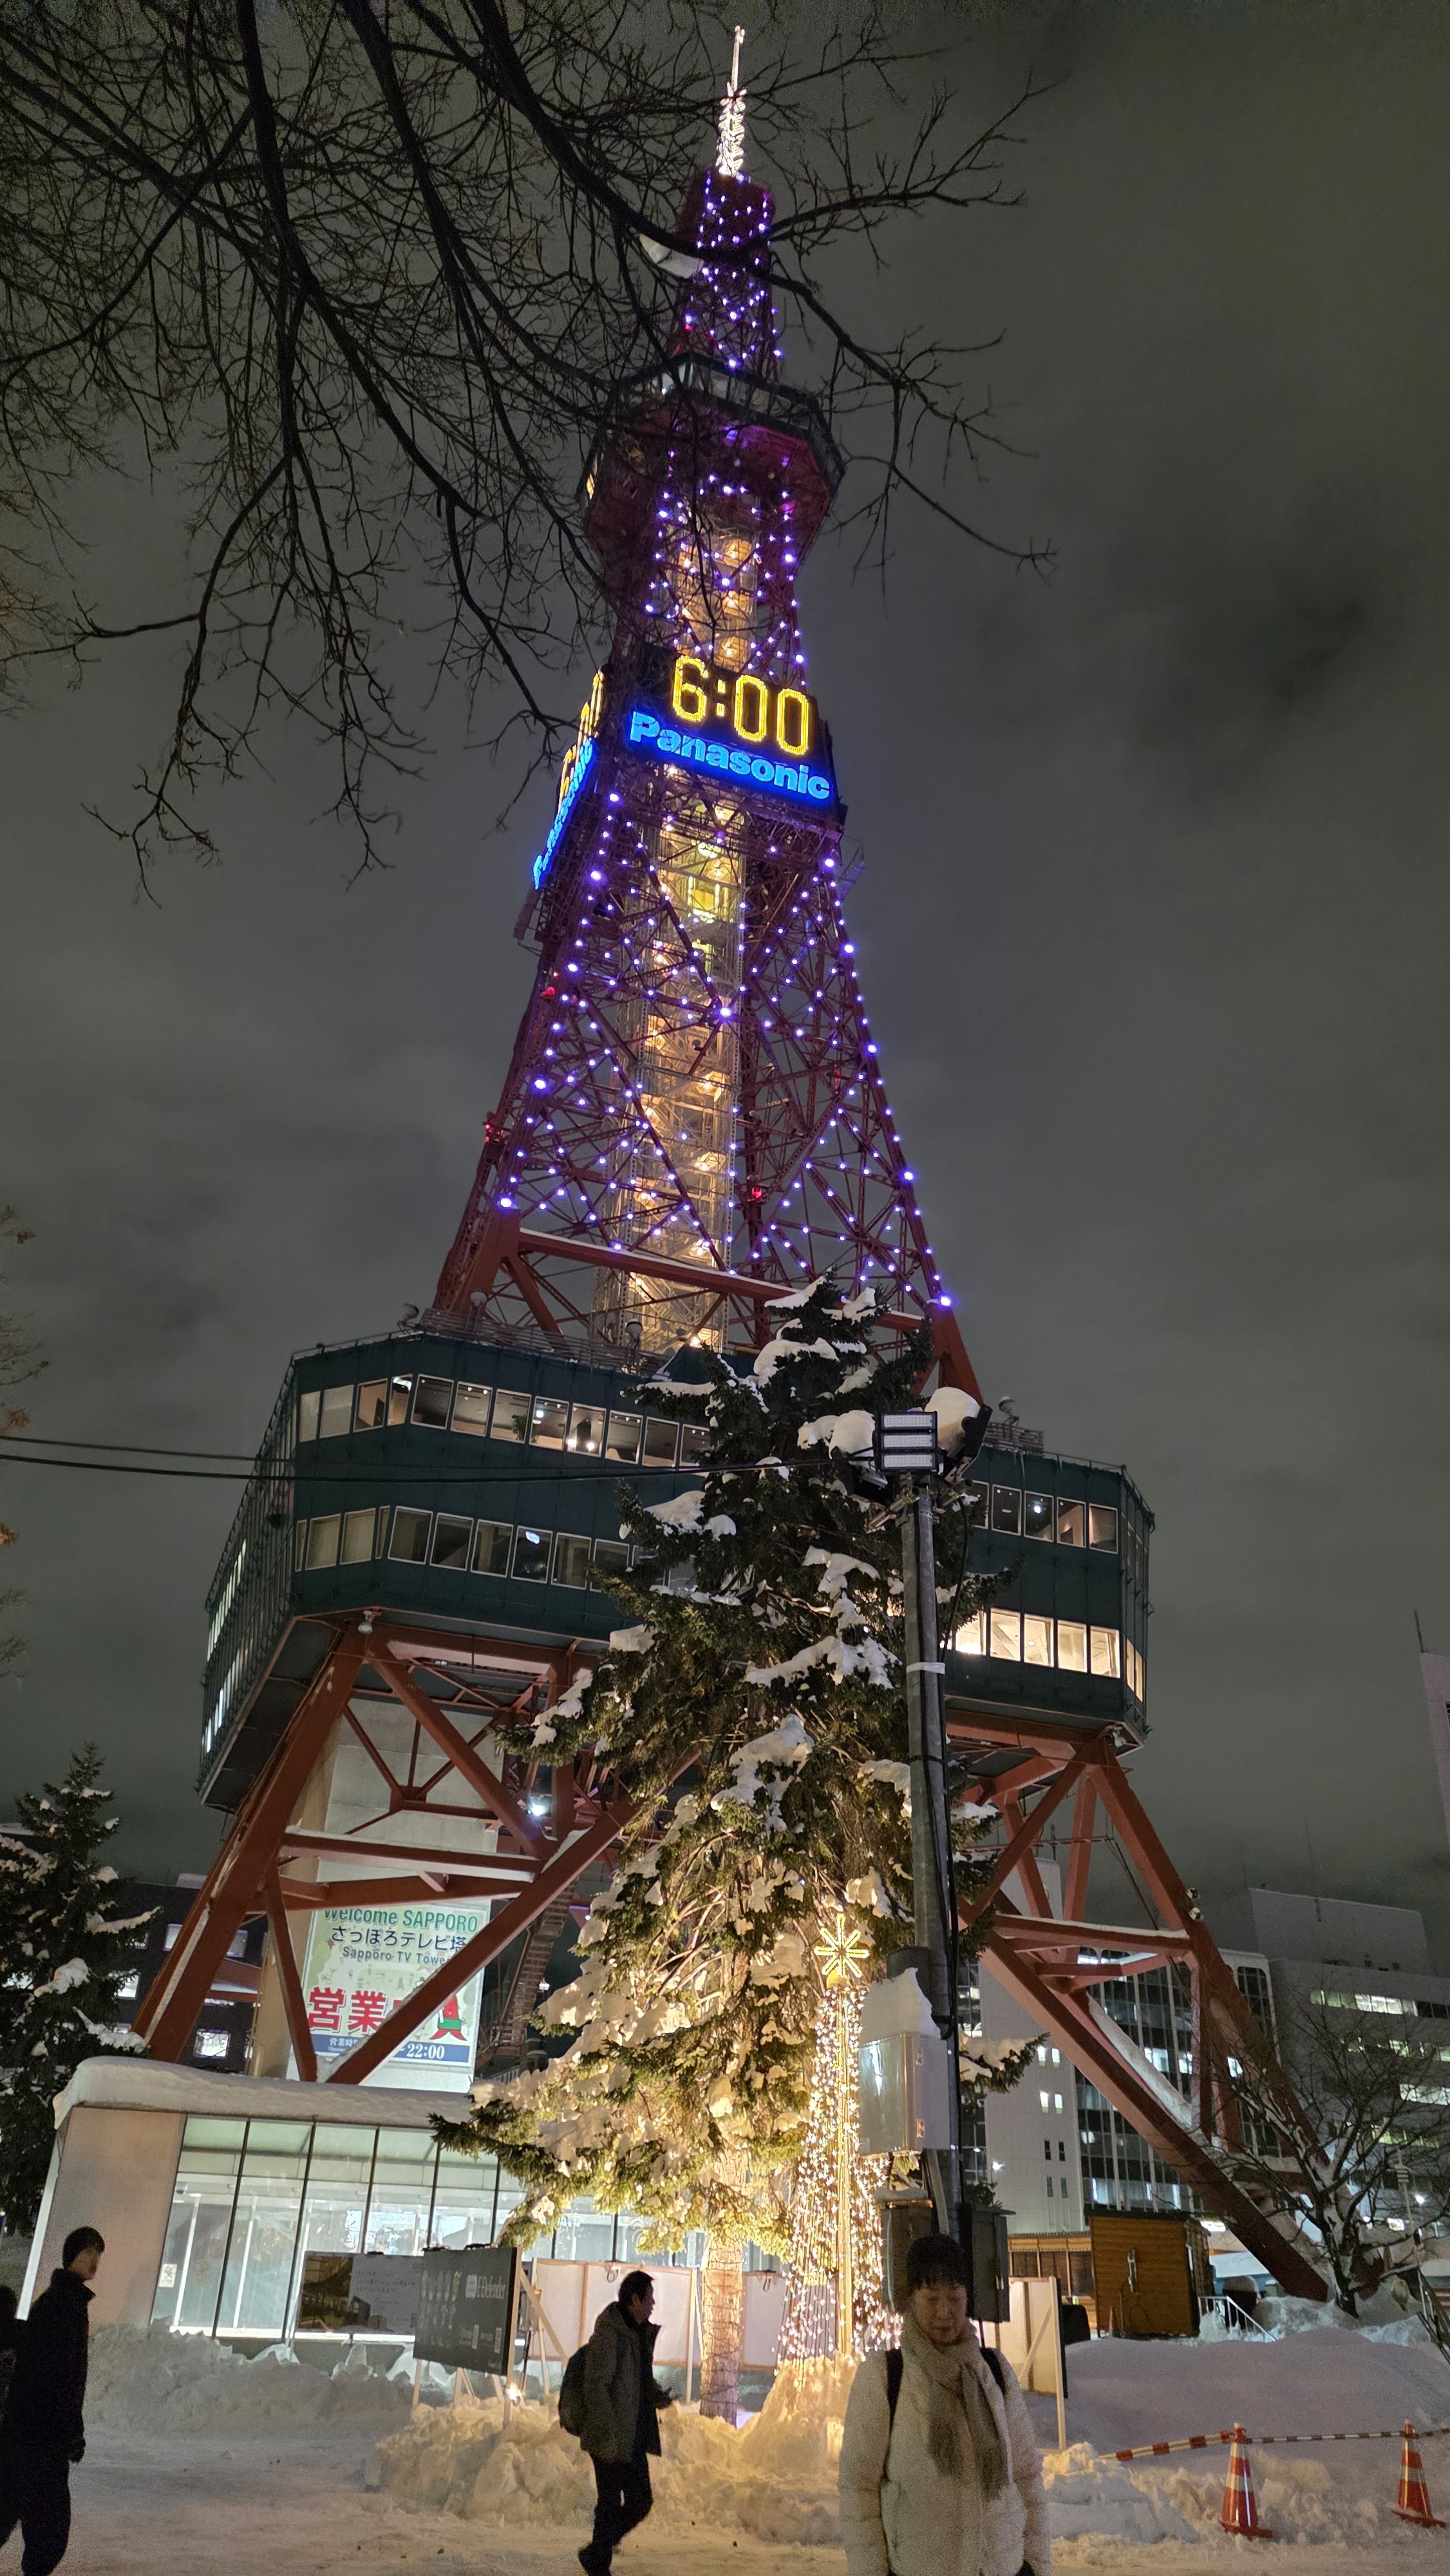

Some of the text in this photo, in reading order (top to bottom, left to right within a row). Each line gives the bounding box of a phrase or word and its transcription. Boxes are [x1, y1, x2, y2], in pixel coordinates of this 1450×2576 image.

[672, 654, 810, 755] 6:00
[629, 710, 831, 800] Panasonic
[402, 1909, 478, 1932] SAPPORO
[332, 1926, 468, 1953] さっぽろテレビ塔
[343, 1946, 392, 1962] Sapporo
[398, 1951, 412, 1962] TV
[308, 1986, 409, 2033] 営業
